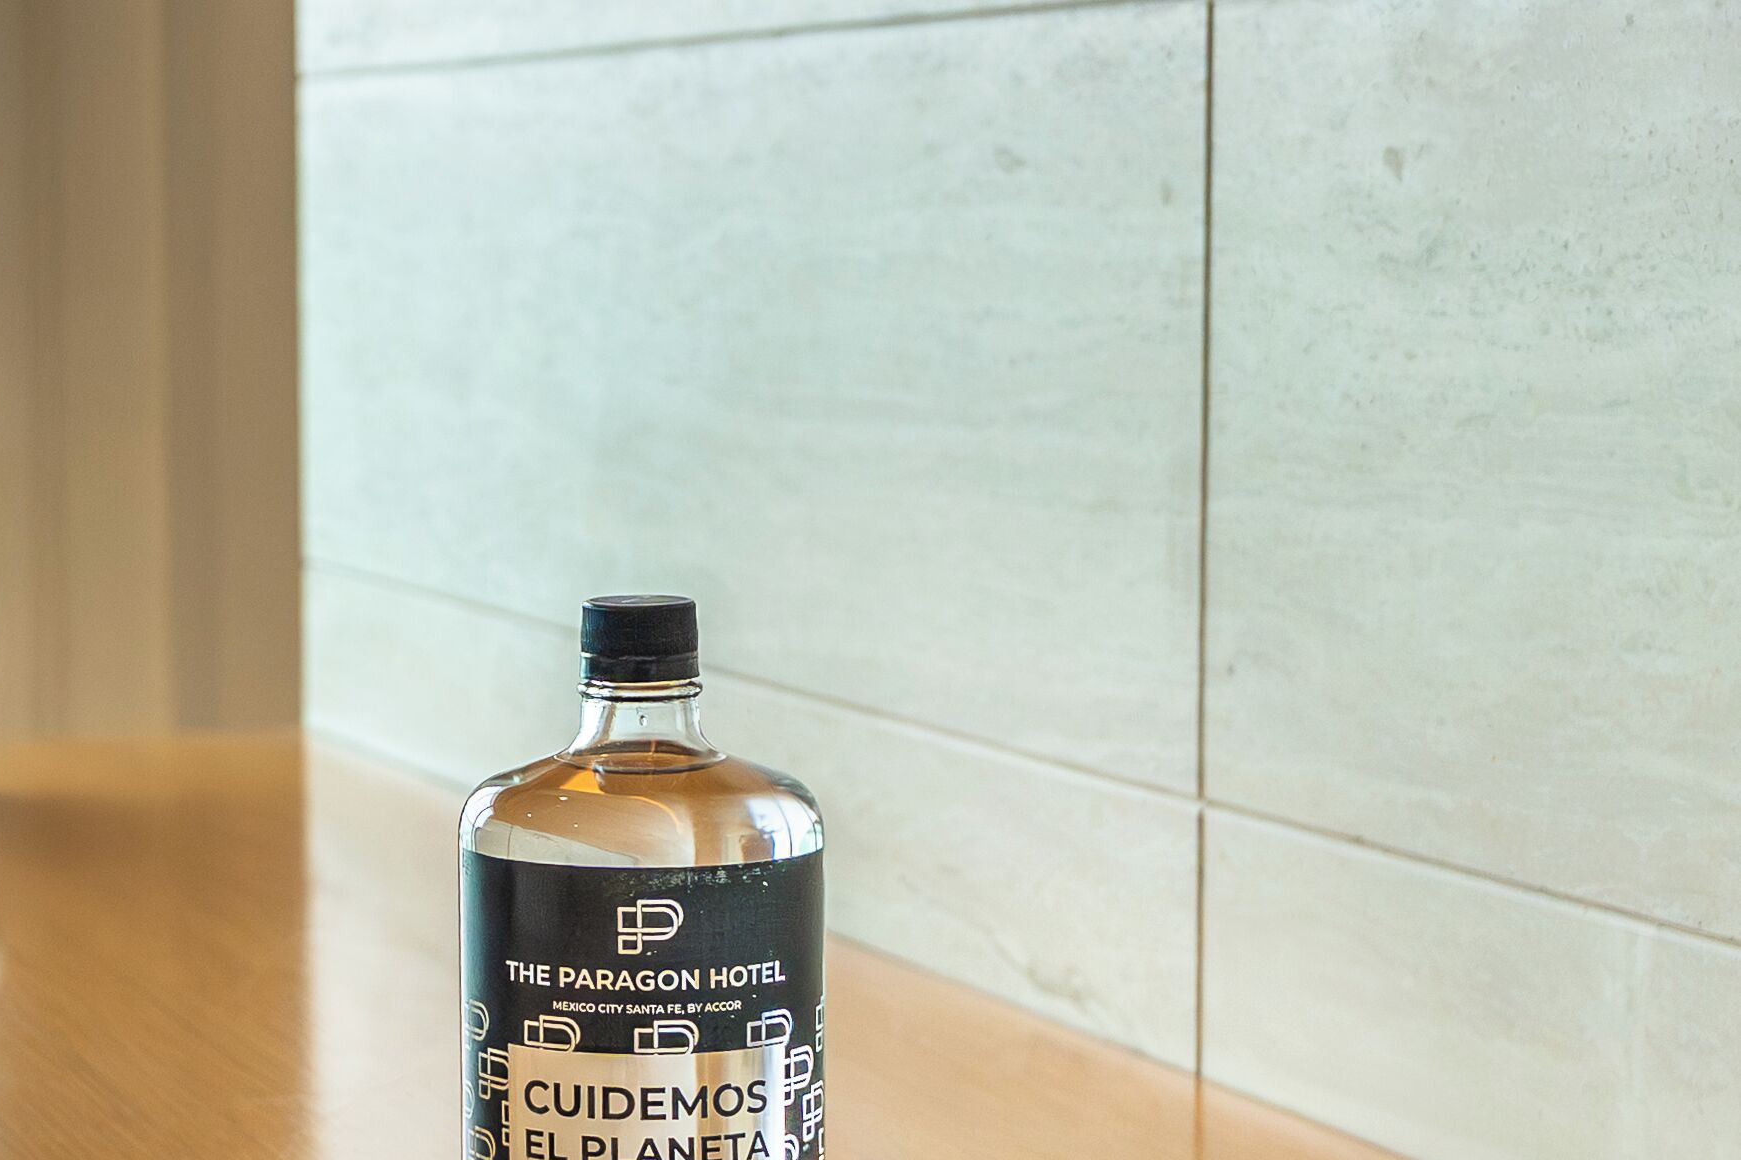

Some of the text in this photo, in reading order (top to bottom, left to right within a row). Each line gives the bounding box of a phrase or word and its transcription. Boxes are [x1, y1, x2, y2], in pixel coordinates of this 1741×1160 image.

[505, 959, 786, 992] THE PARAGON HOTEL
[552, 1000, 742, 1015] MEXICO CITY SANTA FE, BY ACCOR
[524, 1080, 768, 1121] CUIDEMOS
